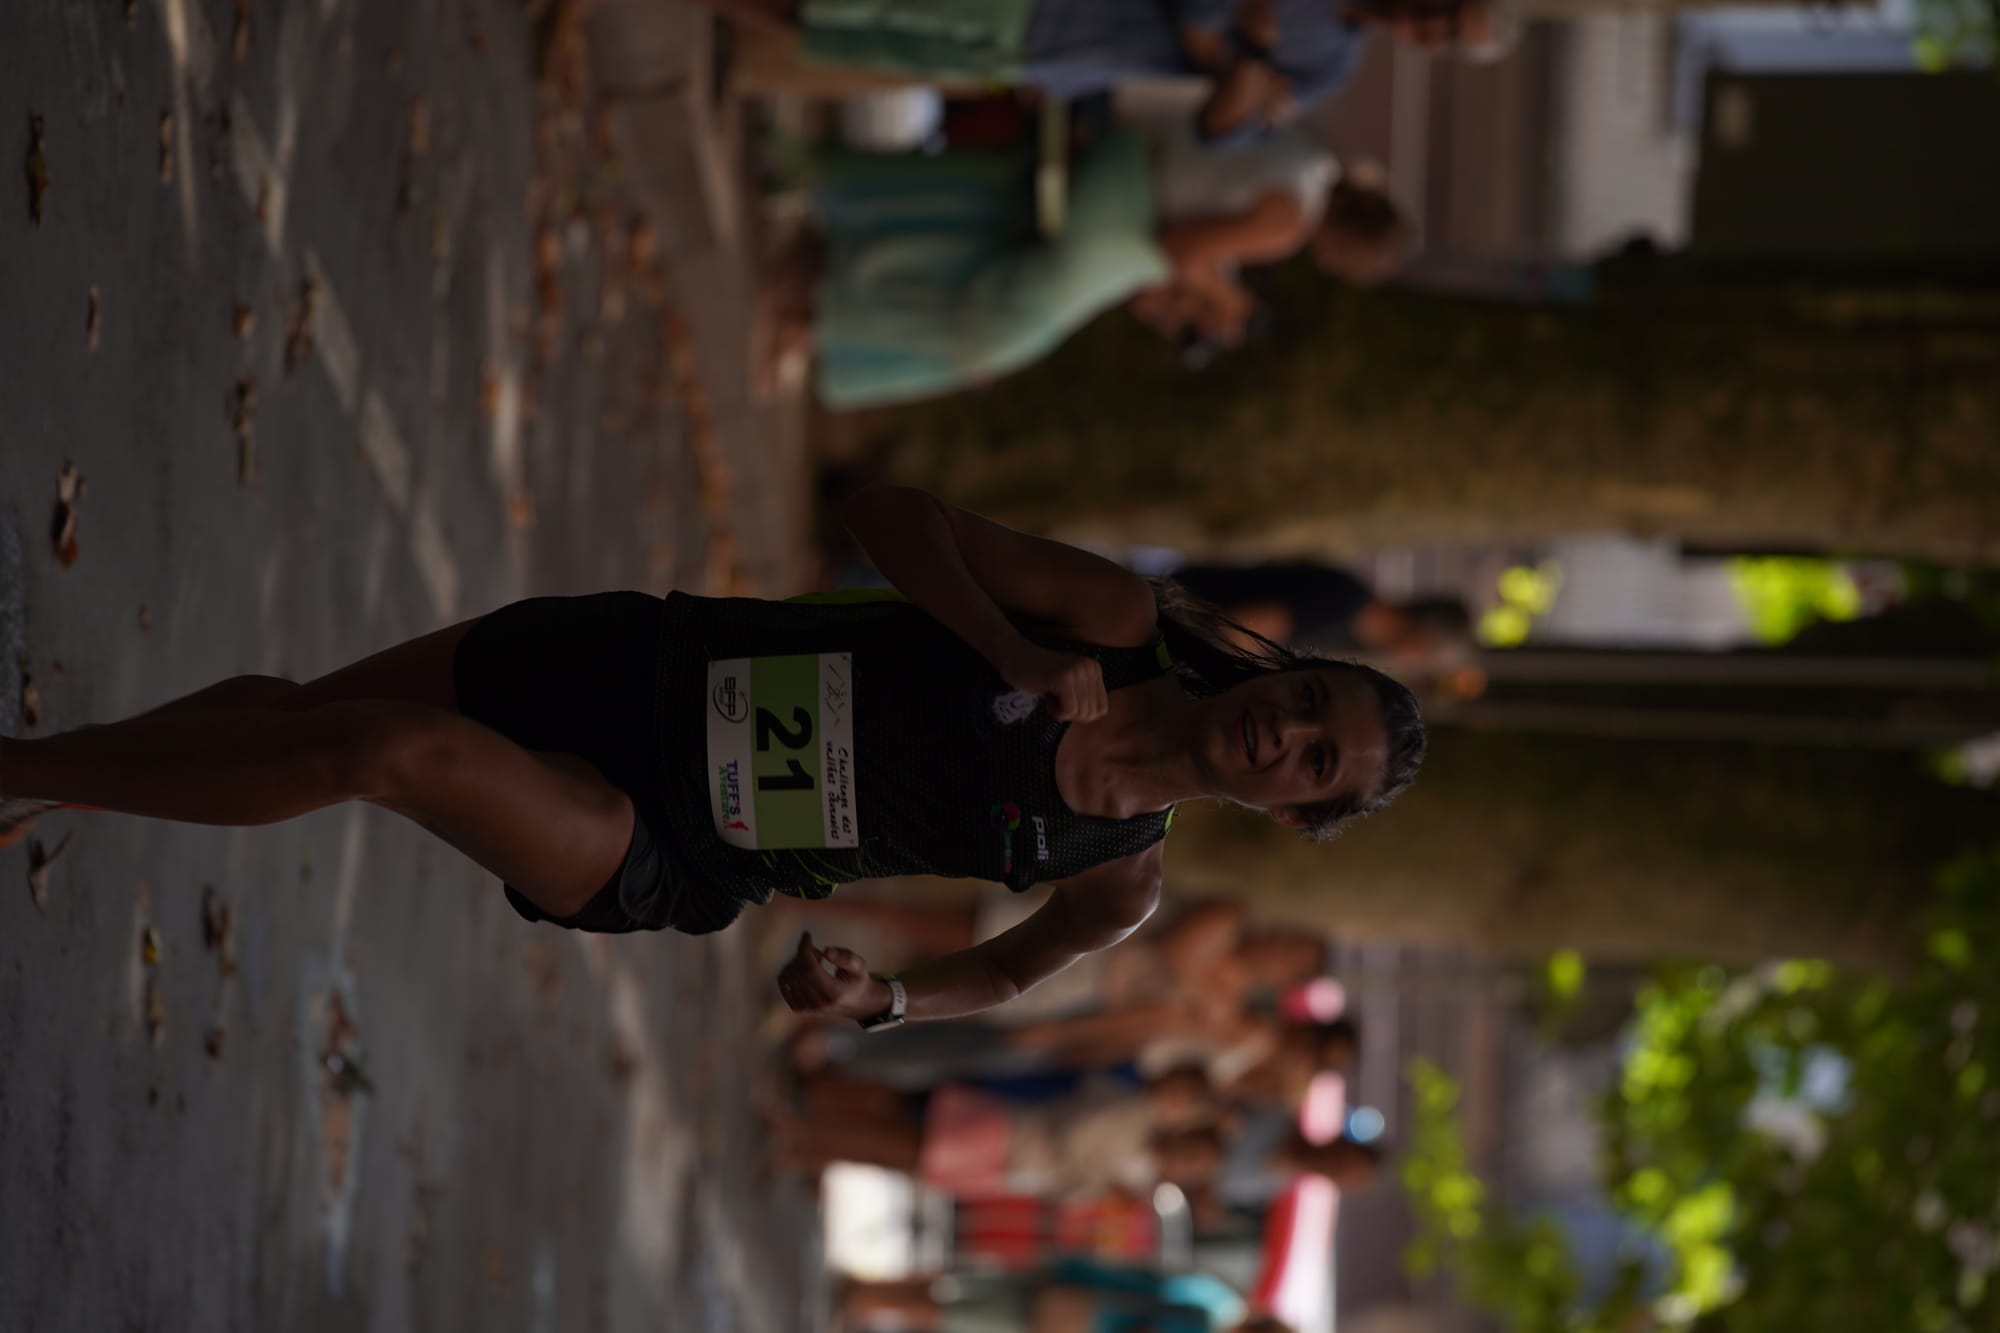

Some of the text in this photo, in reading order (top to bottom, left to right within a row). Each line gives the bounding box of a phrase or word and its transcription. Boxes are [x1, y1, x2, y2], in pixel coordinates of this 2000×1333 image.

[757, 706, 815, 792] 21
[726, 760, 741, 815] TUFF'S
[1032, 815, 1049, 861] poli
